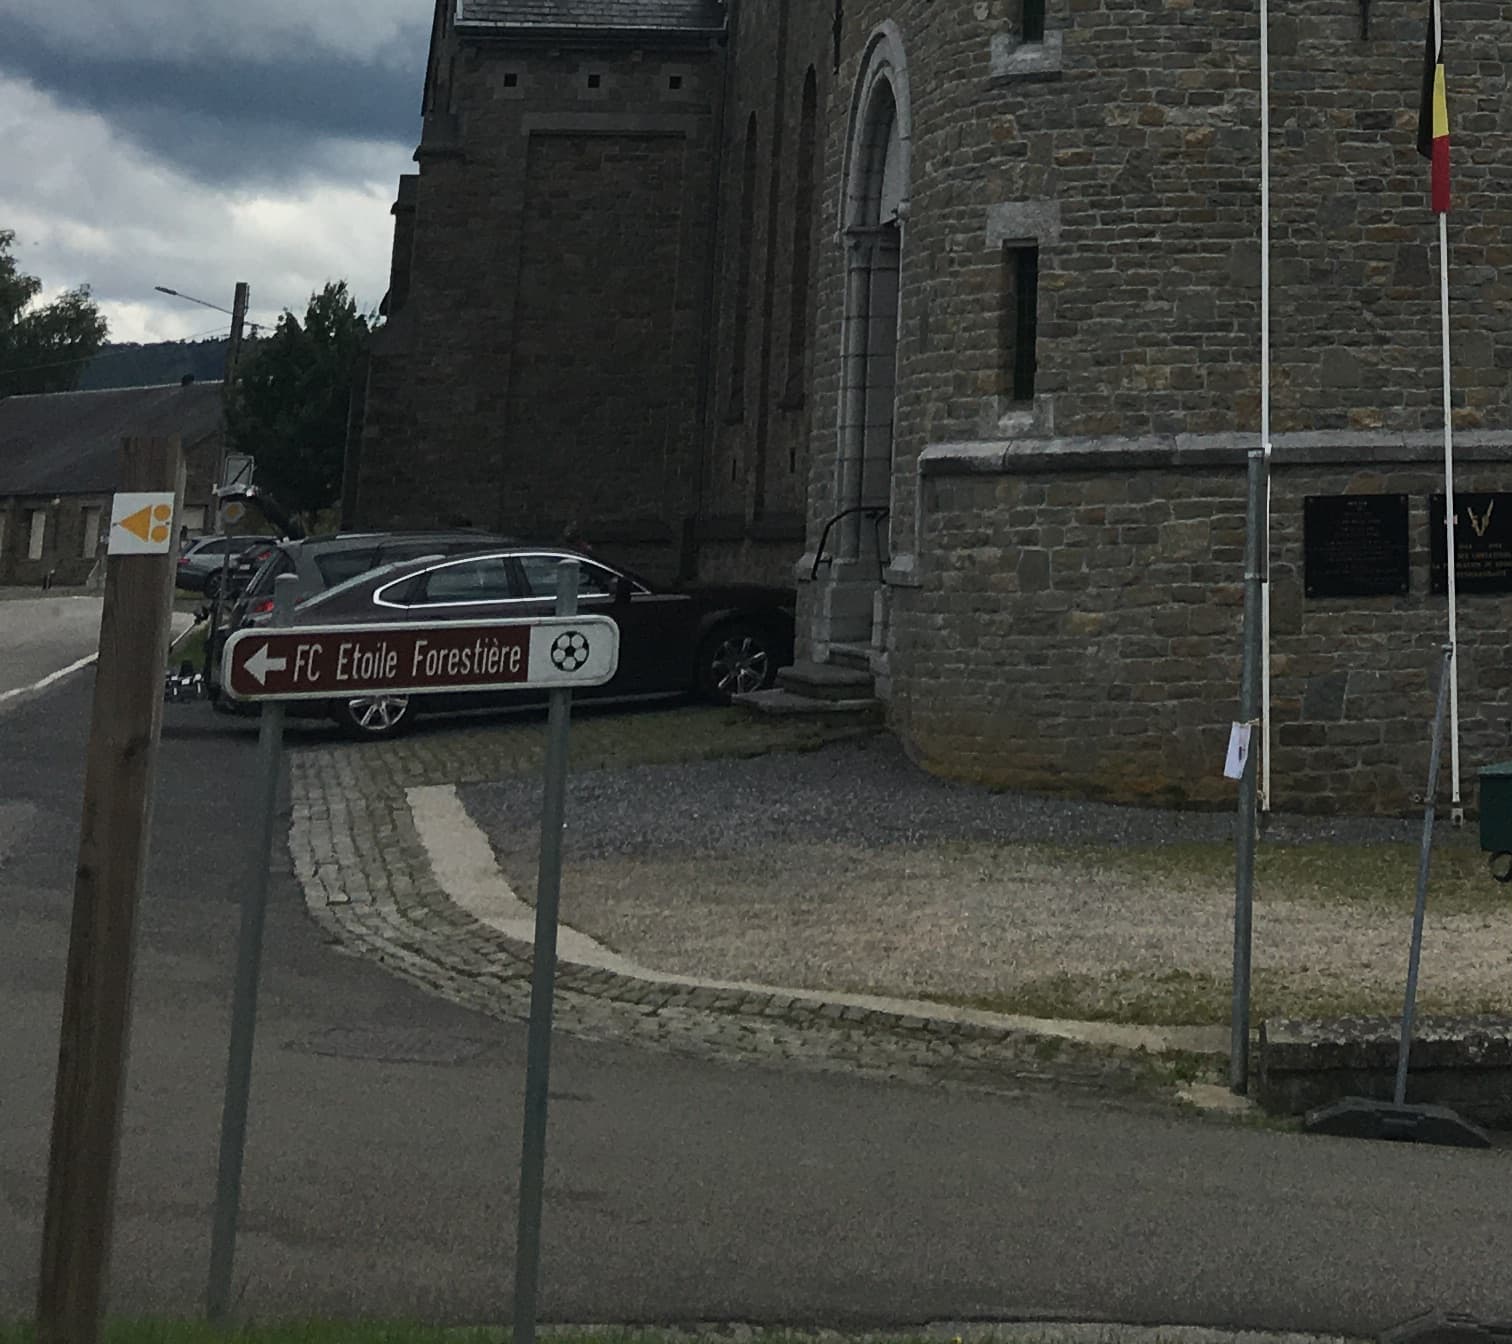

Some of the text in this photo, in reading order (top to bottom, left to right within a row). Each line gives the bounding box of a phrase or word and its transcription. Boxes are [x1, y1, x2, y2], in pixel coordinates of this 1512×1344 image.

[293, 638, 522, 683] FC Etoile Forestière
